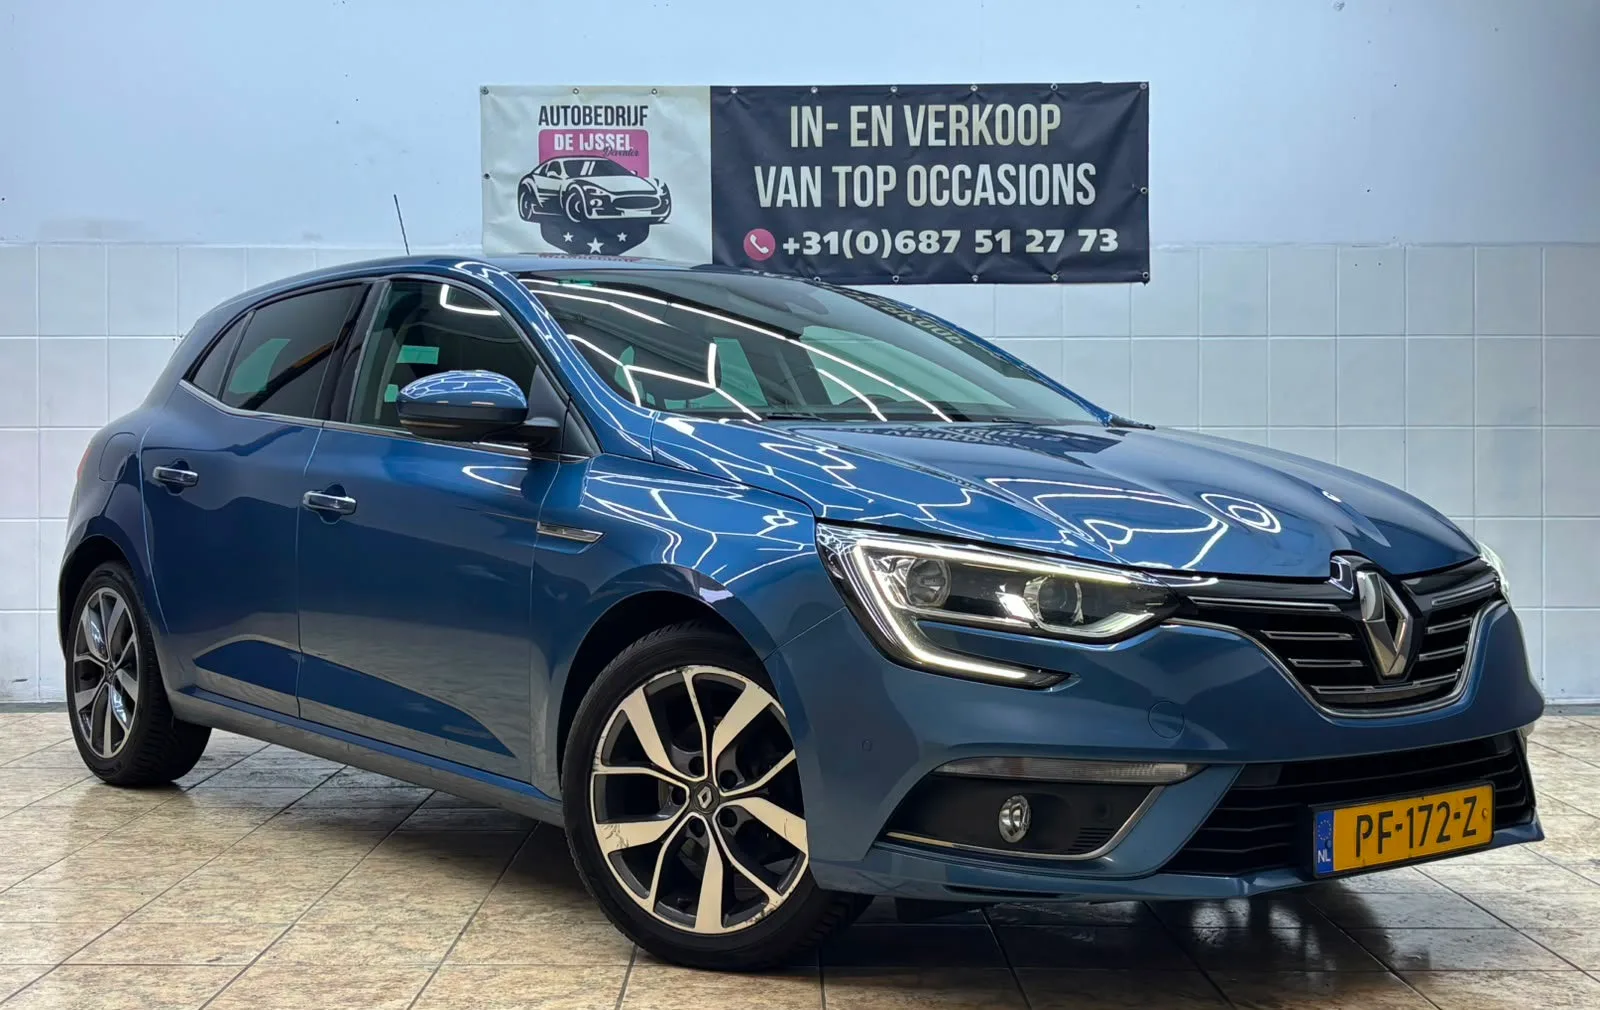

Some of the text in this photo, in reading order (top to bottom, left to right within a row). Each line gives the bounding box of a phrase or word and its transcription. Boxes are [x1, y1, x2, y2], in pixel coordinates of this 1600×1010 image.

[538, 105, 649, 127] AUTOBEDRIJF
[790, 103, 1061, 148] IN- EN VERKOOP
[554, 133, 631, 151] DE IJSSEL
[754, 162, 1097, 208] VAN TOP OCCASIONS
[782, 228, 1119, 260] +31(0)687 51 27 73
[1356, 795, 1478, 858] PF-172-Z
[1317, 848, 1332, 864] NL
